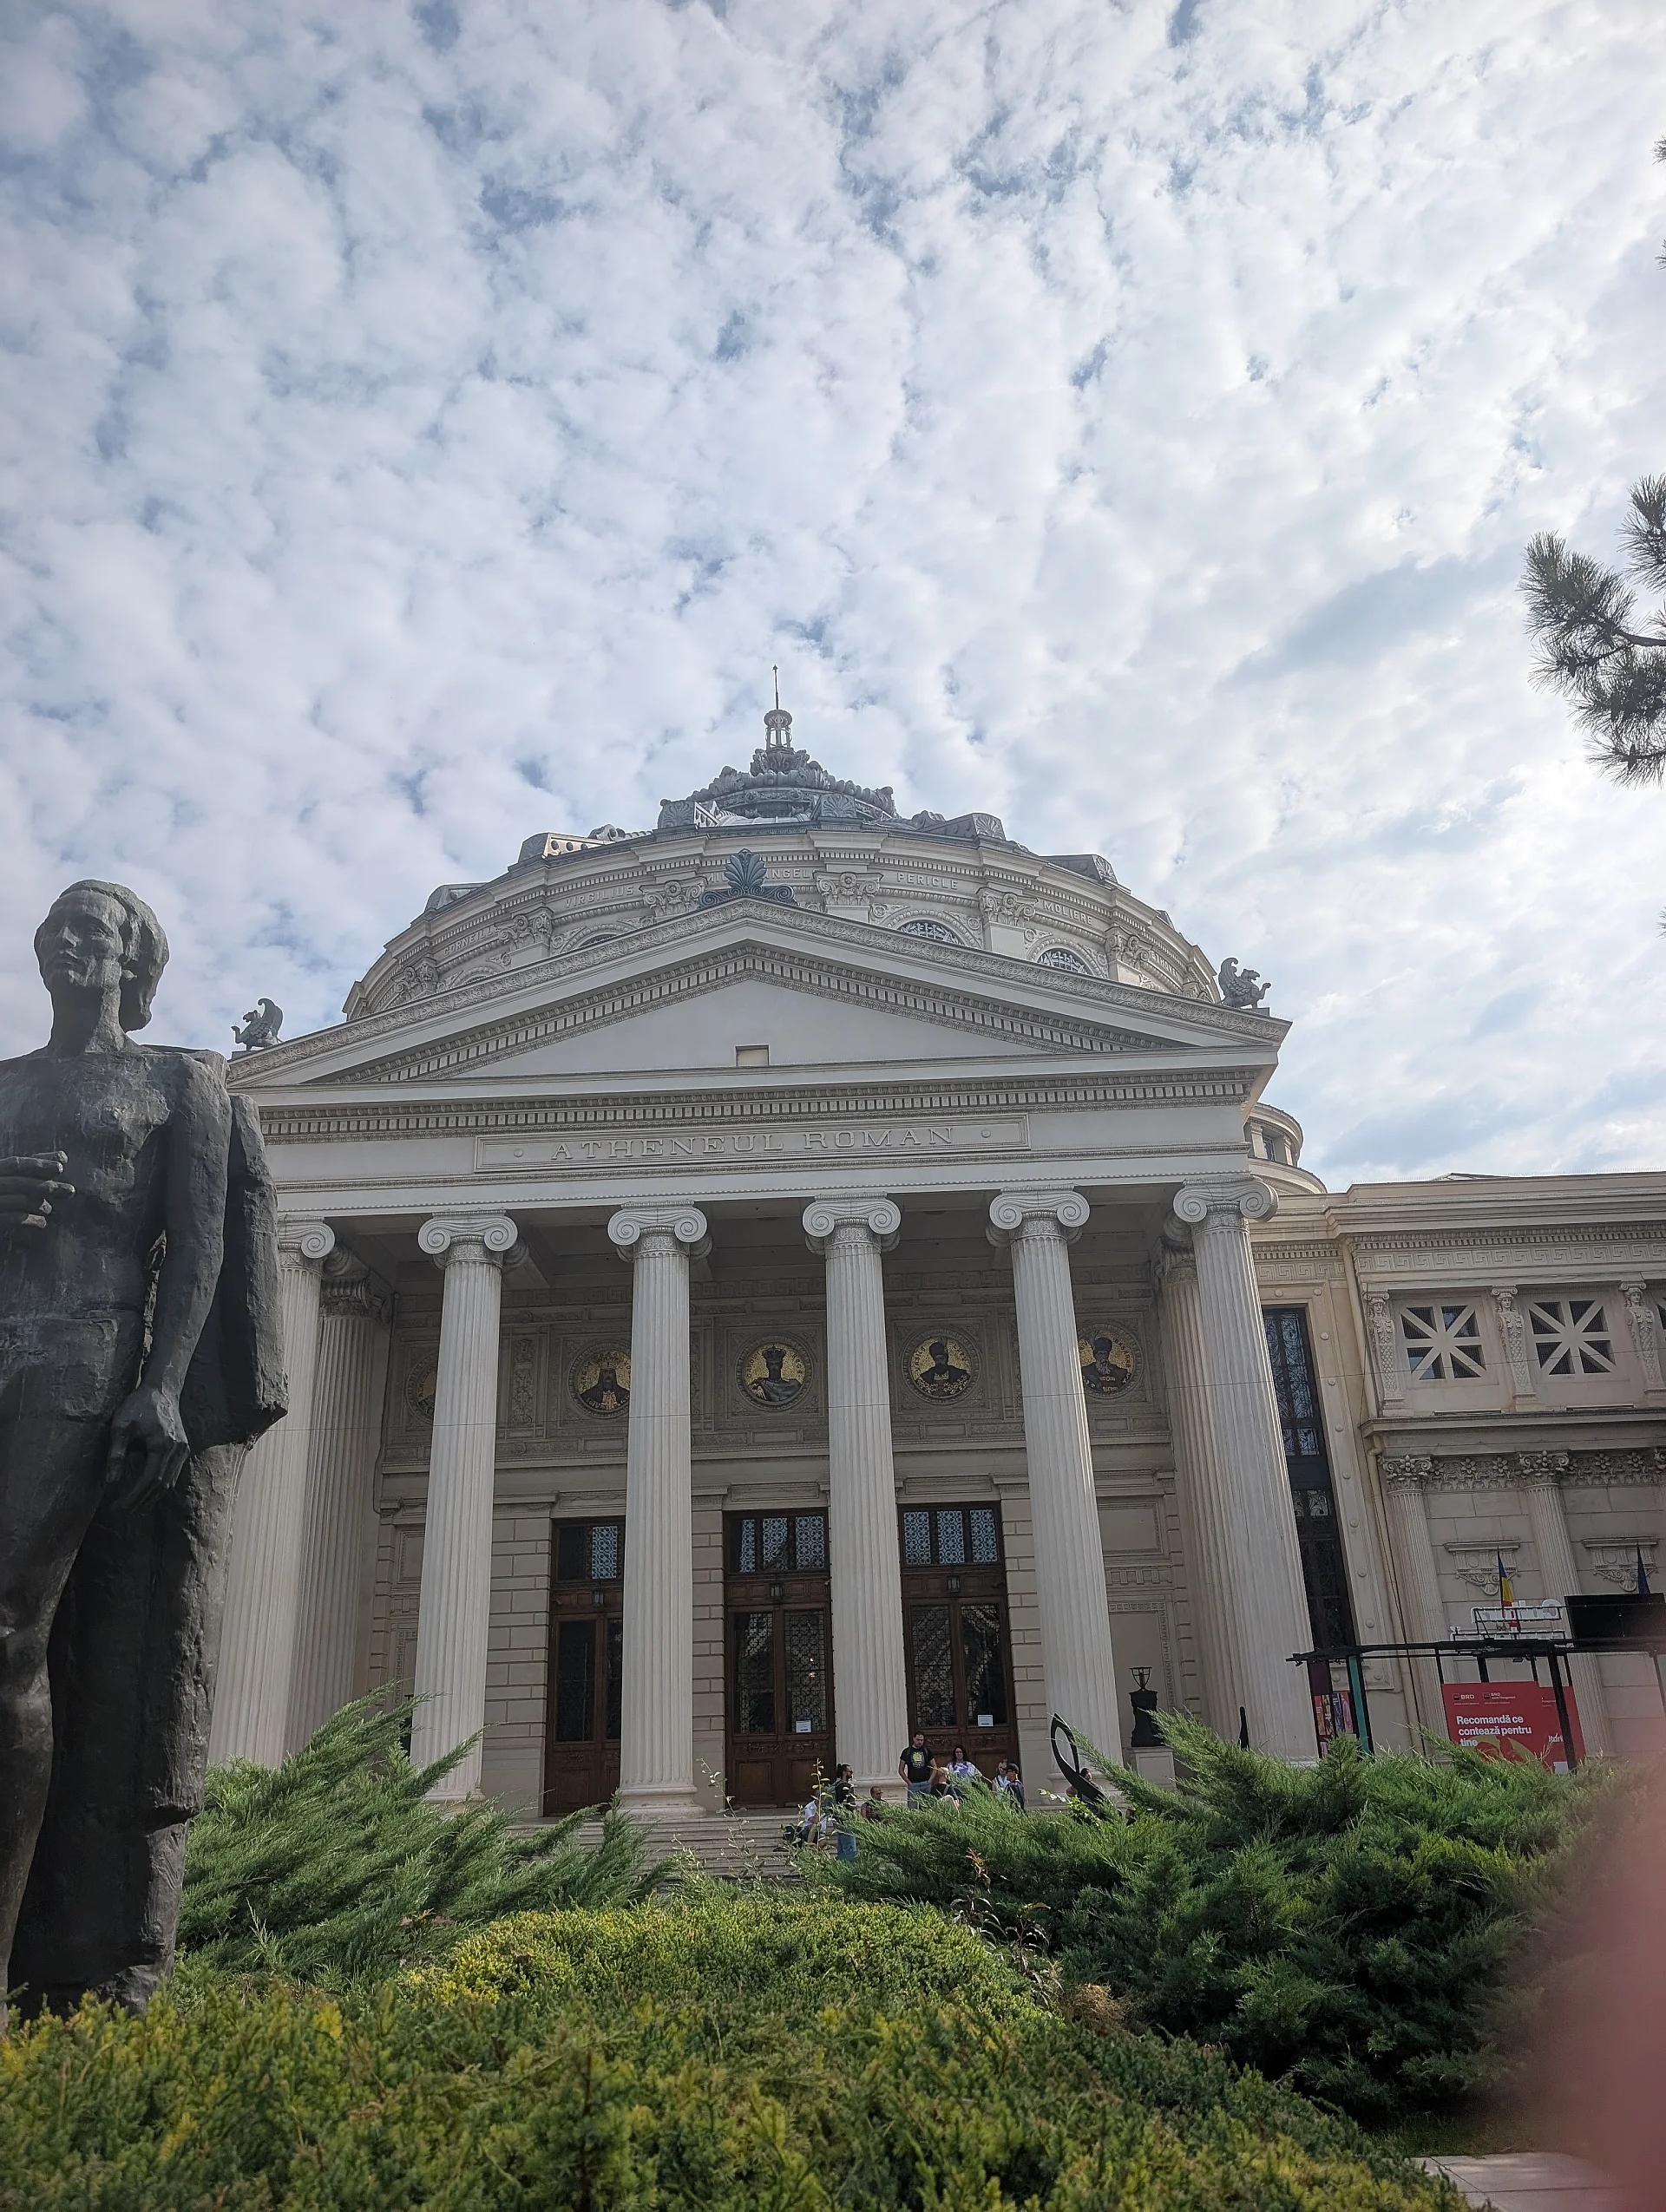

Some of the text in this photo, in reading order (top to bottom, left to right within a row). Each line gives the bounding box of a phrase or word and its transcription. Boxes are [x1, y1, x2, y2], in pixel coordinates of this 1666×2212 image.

[763, 868, 817, 880] ANGEL
[896, 872, 958, 891] PERICLE
[565, 885, 634, 908] VIRGILIUS
[1042, 900, 1093, 926] MOLIERE
[443, 925, 500, 956] CORNEILL
[550, 1127, 954, 1161] ATHENEUL ROMAN
[1456, 1714, 1511, 1725] Recomandă
[1458, 1725, 1532, 1736] contează pentru
[1459, 1738, 1479, 1747] tine
